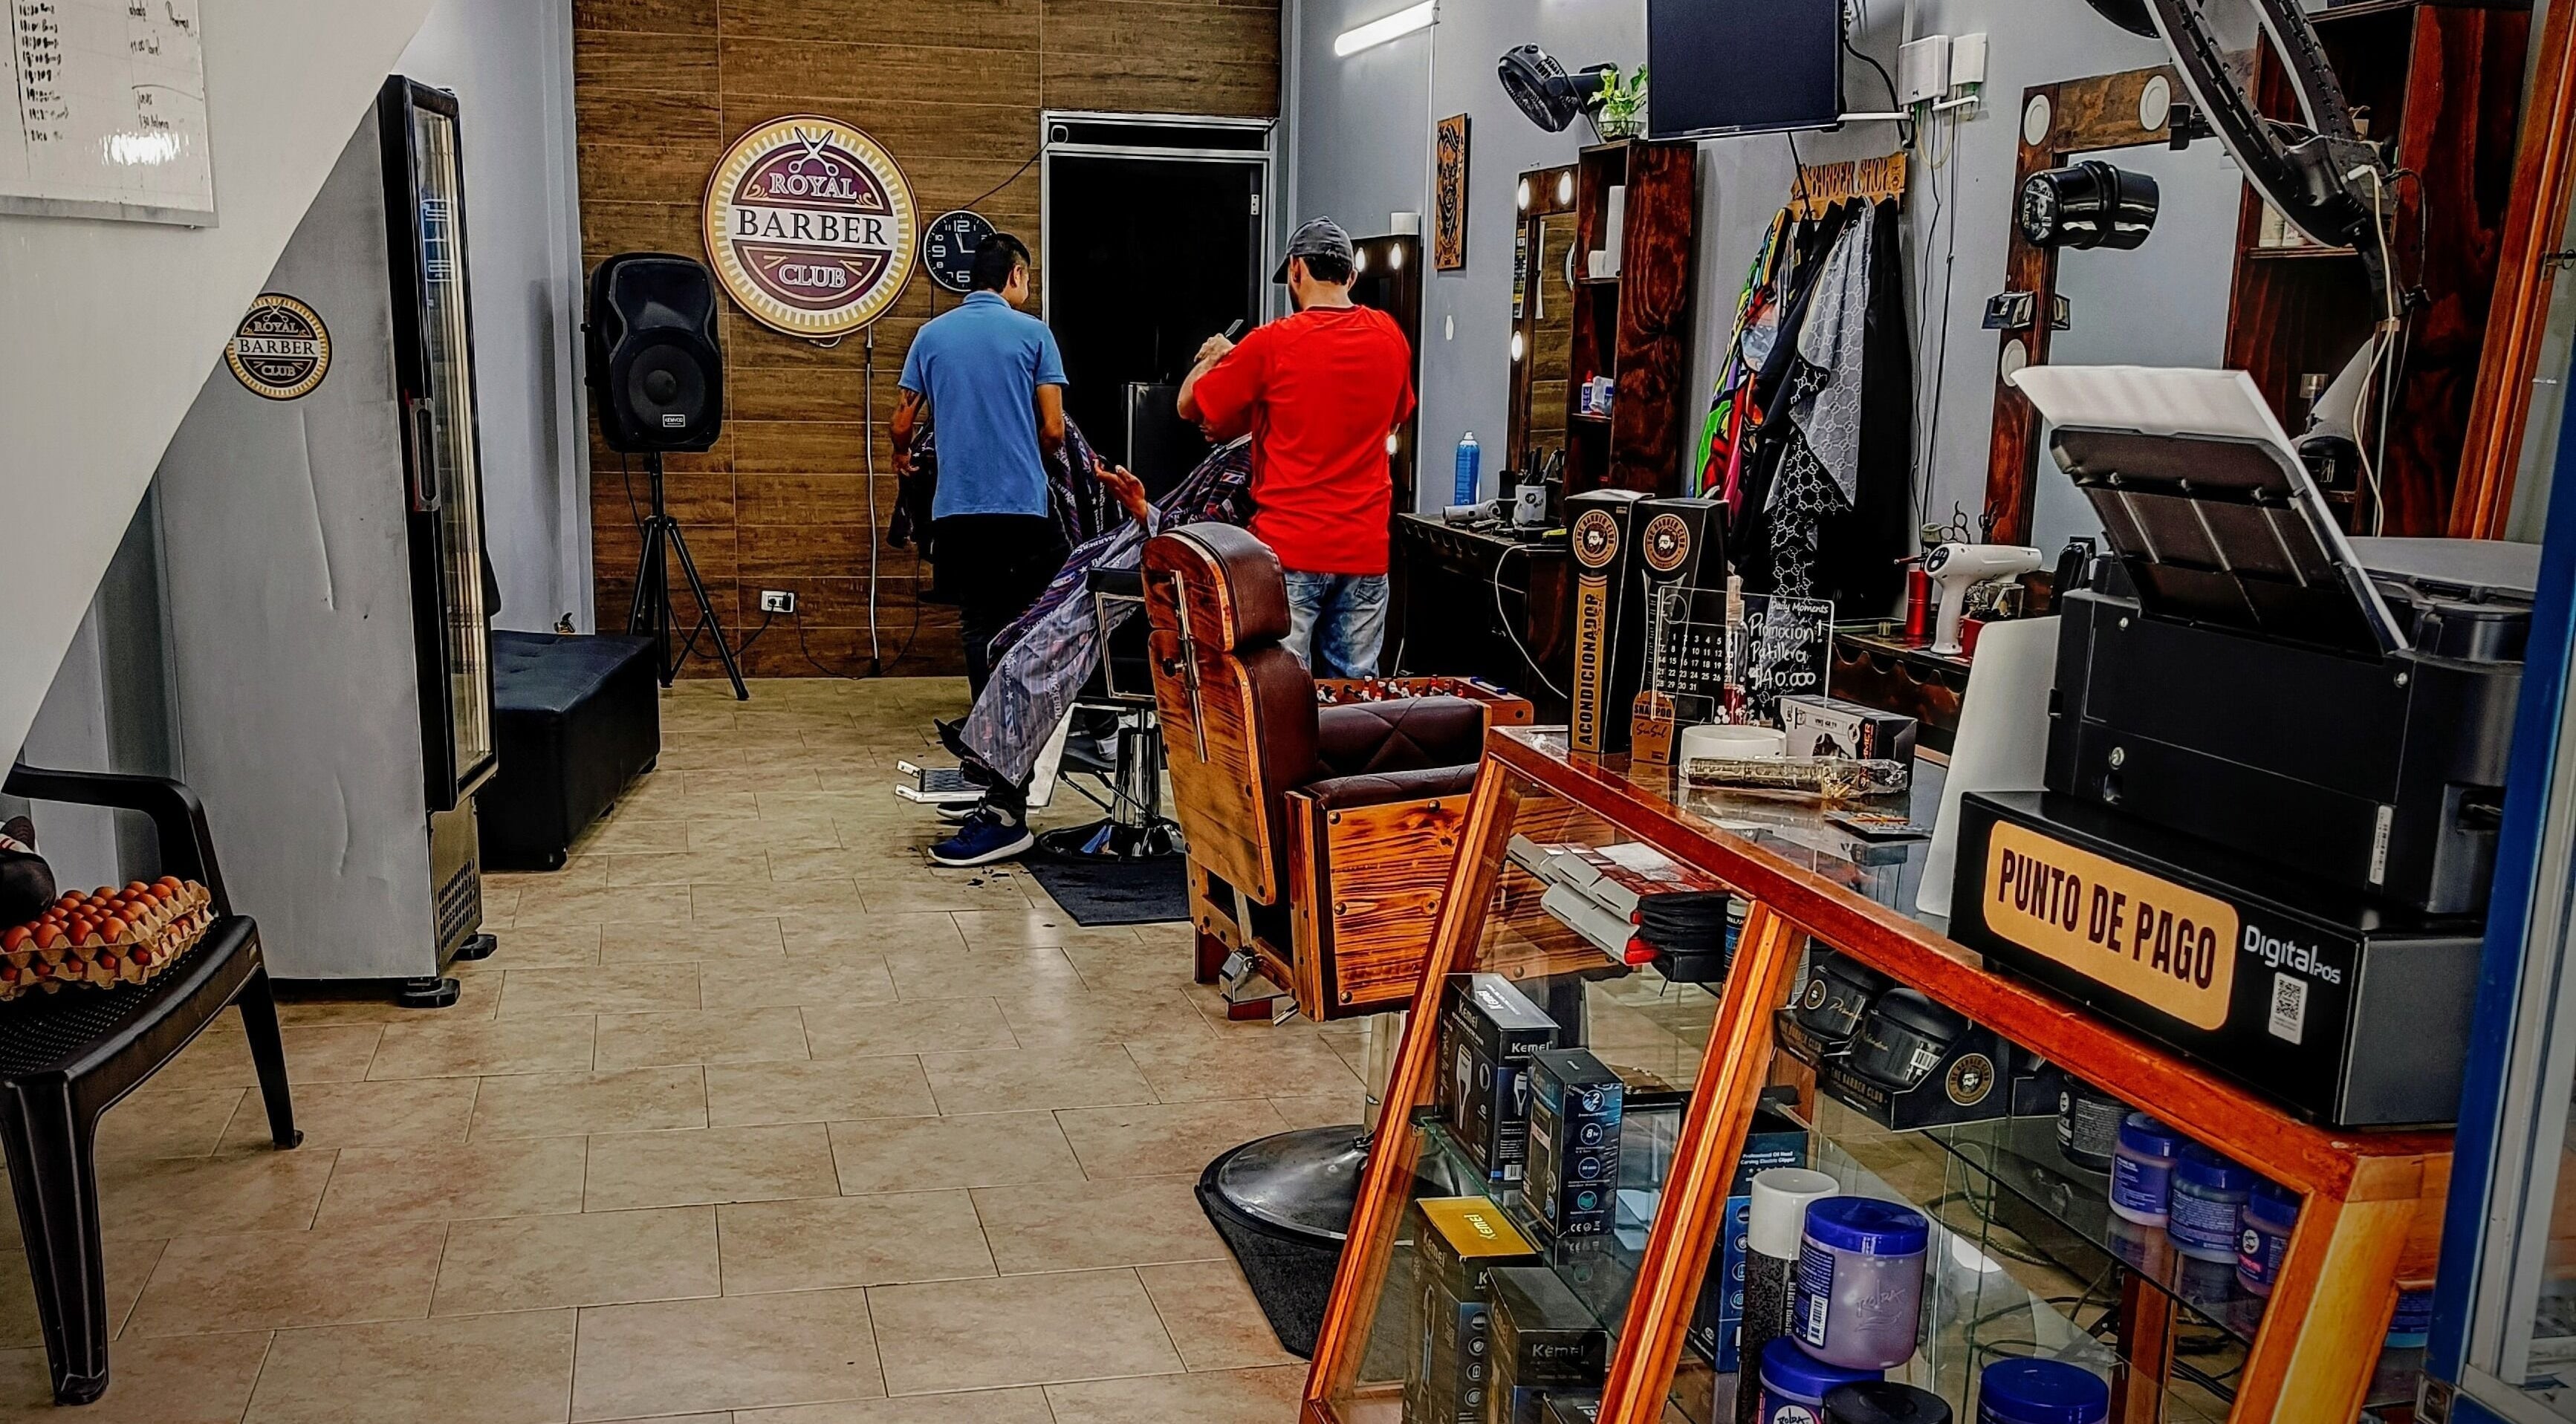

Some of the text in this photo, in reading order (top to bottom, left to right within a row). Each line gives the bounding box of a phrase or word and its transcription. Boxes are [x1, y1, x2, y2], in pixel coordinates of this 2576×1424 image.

[769, 172, 857, 199] ROYAL
[736, 209, 888, 245] BARBER
[954, 220, 970, 233] 12
[932, 245, 946, 258] 9
[779, 264, 846, 287] CLUB
[956, 270, 970, 283] 6
[253, 321, 299, 333] ROYAL
[239, 339, 316, 355] BARBER
[261, 365, 296, 377] CLUB
[1583, 515, 1606, 527] BARBER
[1605, 524, 1615, 544] CLUB
[1647, 518, 1685, 549] THE BARBER CLUB
[1771, 597, 1829, 614] Daily Moments
[1694, 635, 1699, 643] 3
[1716, 637, 1722, 646] 5
[1692, 647, 1700, 655] 10
[1703, 648, 1711, 657] 11
[1578, 594, 1598, 747] ACONDICIONADOR
[1702, 660, 1710, 669] 18
[1679, 670, 1687, 678] 23
[1701, 672, 1710, 680] 25
[1713, 674, 1722, 682] 26
[1678, 682, 1687, 690] 30
[1634, 703, 1673, 718] SHAPOO
[1998, 848, 2216, 989] PUNTO DE PAGO
[1956, 1058, 1982, 1071] BARBER
[1981, 1062, 1991, 1082] CLUB
[1842, 1072, 1866, 1096] BARBER
[1866, 1085, 1884, 1104] CLUB
[1592, 1093, 1600, 1104] 2
[1586, 1128, 1594, 1138] 8
